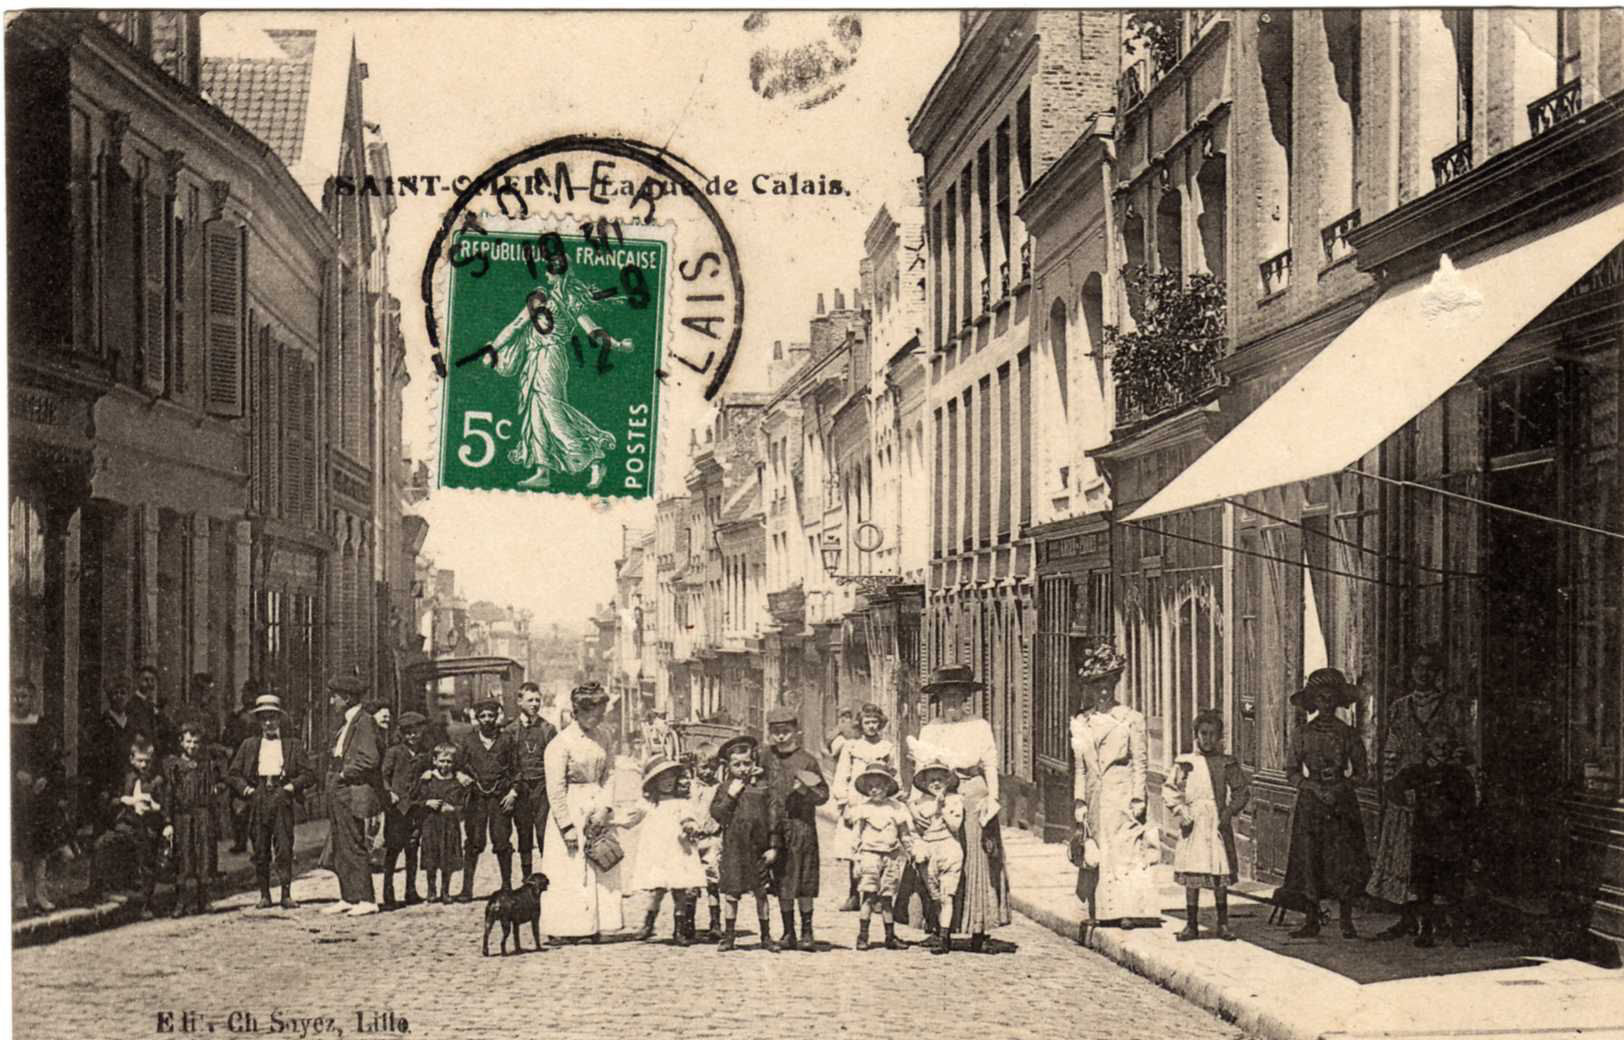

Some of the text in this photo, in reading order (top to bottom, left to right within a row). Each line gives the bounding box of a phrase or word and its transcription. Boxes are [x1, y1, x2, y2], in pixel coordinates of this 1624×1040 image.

[459, 238, 553, 265] REPUBLIQU
[670, 252, 725, 375] LAIS
[625, 403, 648, 489] POSTES
